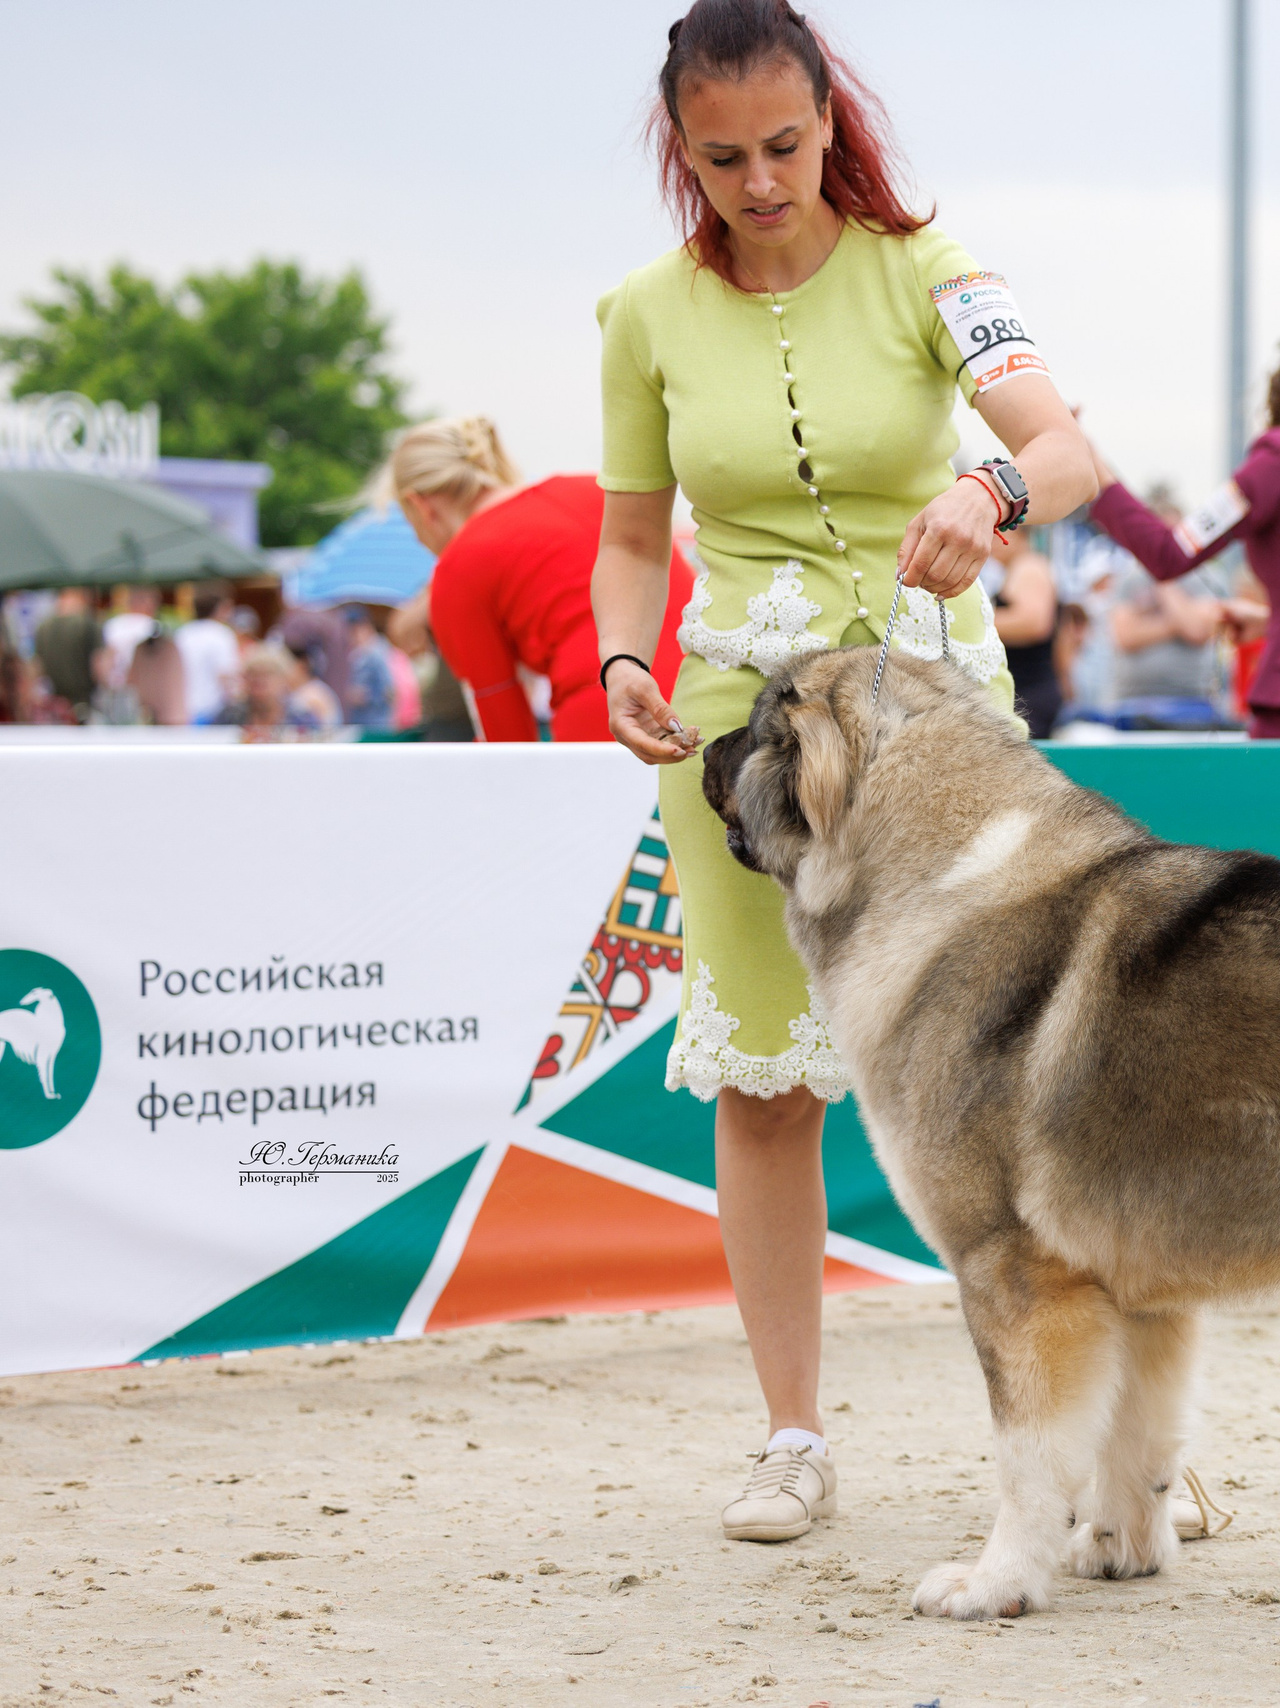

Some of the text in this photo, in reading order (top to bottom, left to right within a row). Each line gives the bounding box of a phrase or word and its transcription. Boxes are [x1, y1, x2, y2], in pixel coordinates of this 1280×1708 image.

[970, 318, 1025, 352] 989
[139, 954, 384, 998] Российская
[137, 1015, 479, 1058] кинологическая
[137, 1080, 377, 1133] федерация
